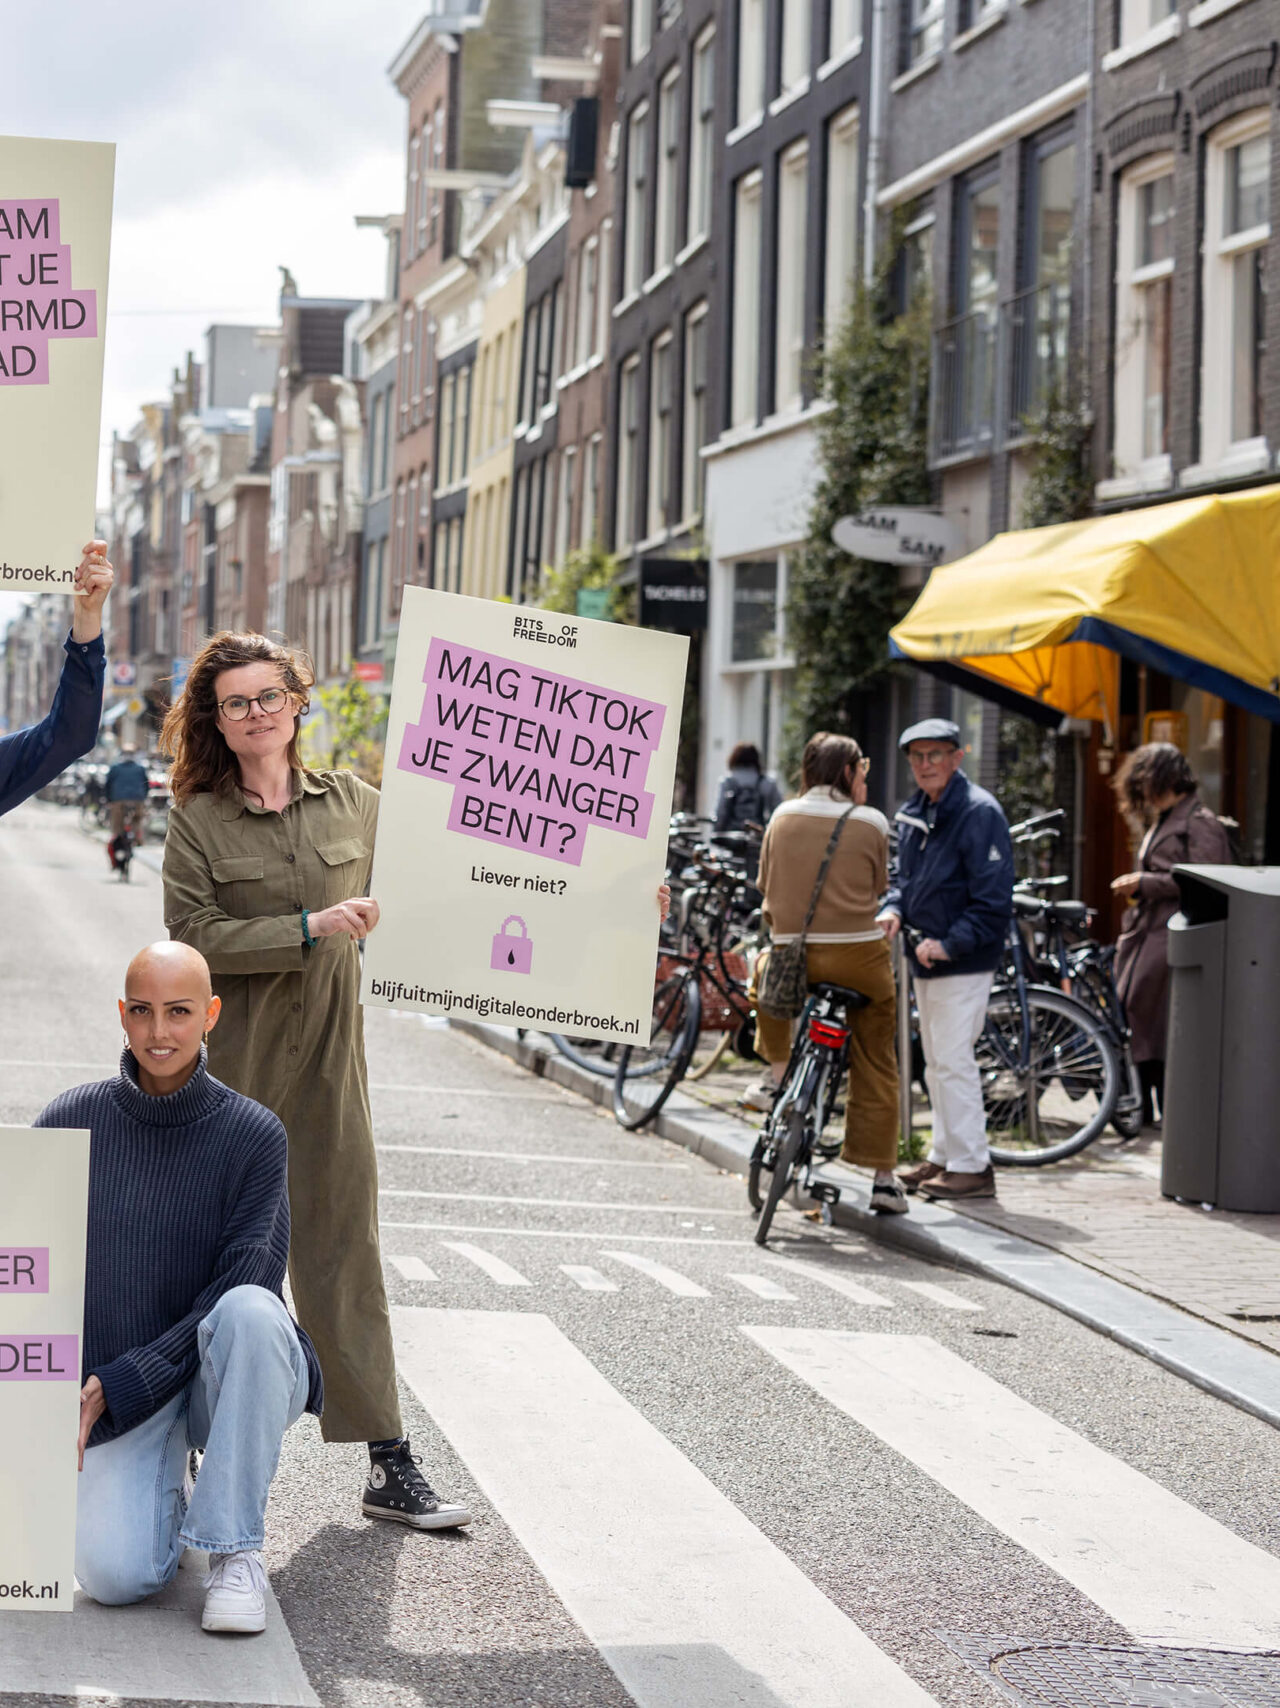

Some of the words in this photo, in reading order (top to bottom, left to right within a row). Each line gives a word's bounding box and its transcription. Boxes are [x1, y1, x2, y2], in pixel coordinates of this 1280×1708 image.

[17, 253, 60, 286] JE
[513, 627, 577, 649] FREEDOM
[514, 616, 543, 631] BITS
[561, 625, 579, 637] OF
[437, 649, 521, 702] MAG
[530, 675, 654, 741] TIKTOK
[436, 693, 562, 759] WETEN
[569, 734, 641, 780] DAT
[411, 737, 454, 774] JE
[459, 748, 640, 829] ZWANGER
[460, 795, 577, 855] BENT?
[471, 866, 521, 890] Liever
[523, 877, 568, 897] niet?
[370, 979, 641, 1035] blijfuitmijndigitaleonderbroek.nl
